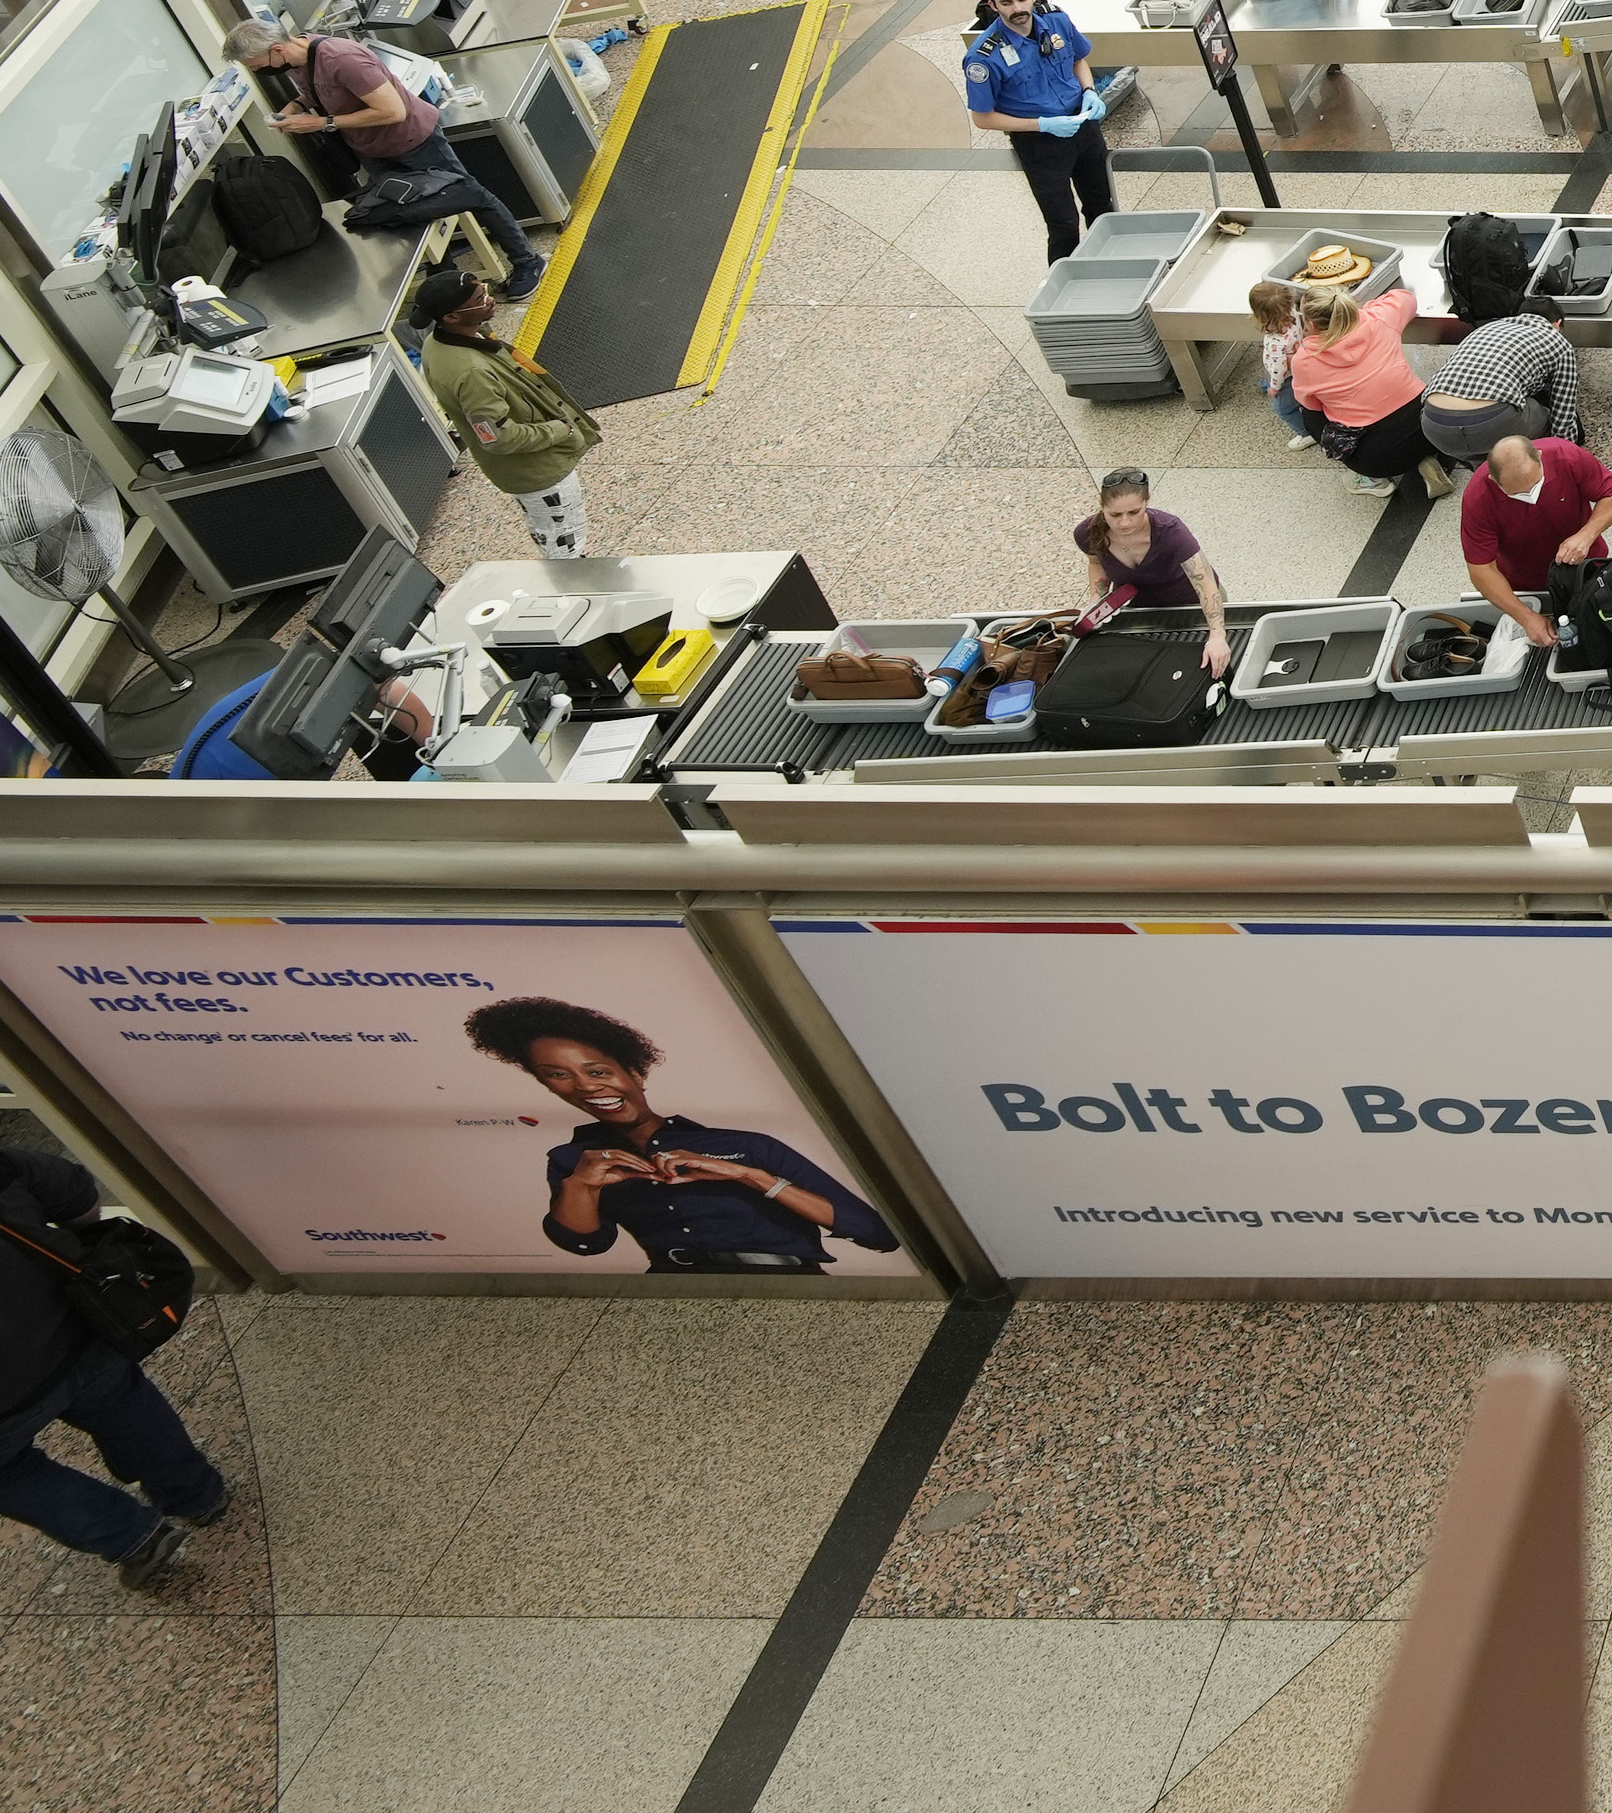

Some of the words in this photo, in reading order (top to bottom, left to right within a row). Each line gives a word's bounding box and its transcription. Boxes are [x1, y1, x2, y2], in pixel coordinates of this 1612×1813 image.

[63, 289, 98, 301] iLane
[57, 965, 128, 986] We
[127, 965, 210, 987] love
[216, 967, 279, 986] our
[284, 966, 495, 992] Customers,
[89, 992, 156, 1013] not
[155, 992, 249, 1013] fees.
[119, 1030, 152, 1043] No
[227, 1032, 248, 1043] or
[250, 1031, 310, 1044] cancel
[356, 1031, 386, 1044] for
[388, 1031, 420, 1044] all.
[980, 1082, 1194, 1134] Bolt
[1208, 1085, 1324, 1135] to
[454, 1118, 490, 1127] Karen
[1053, 1205, 1264, 1228] Introducing
[1269, 1209, 1344, 1224] new
[1352, 1206, 1480, 1224] service
[1485, 1207, 1525, 1224] to
[304, 1228, 433, 1243] Southwest
